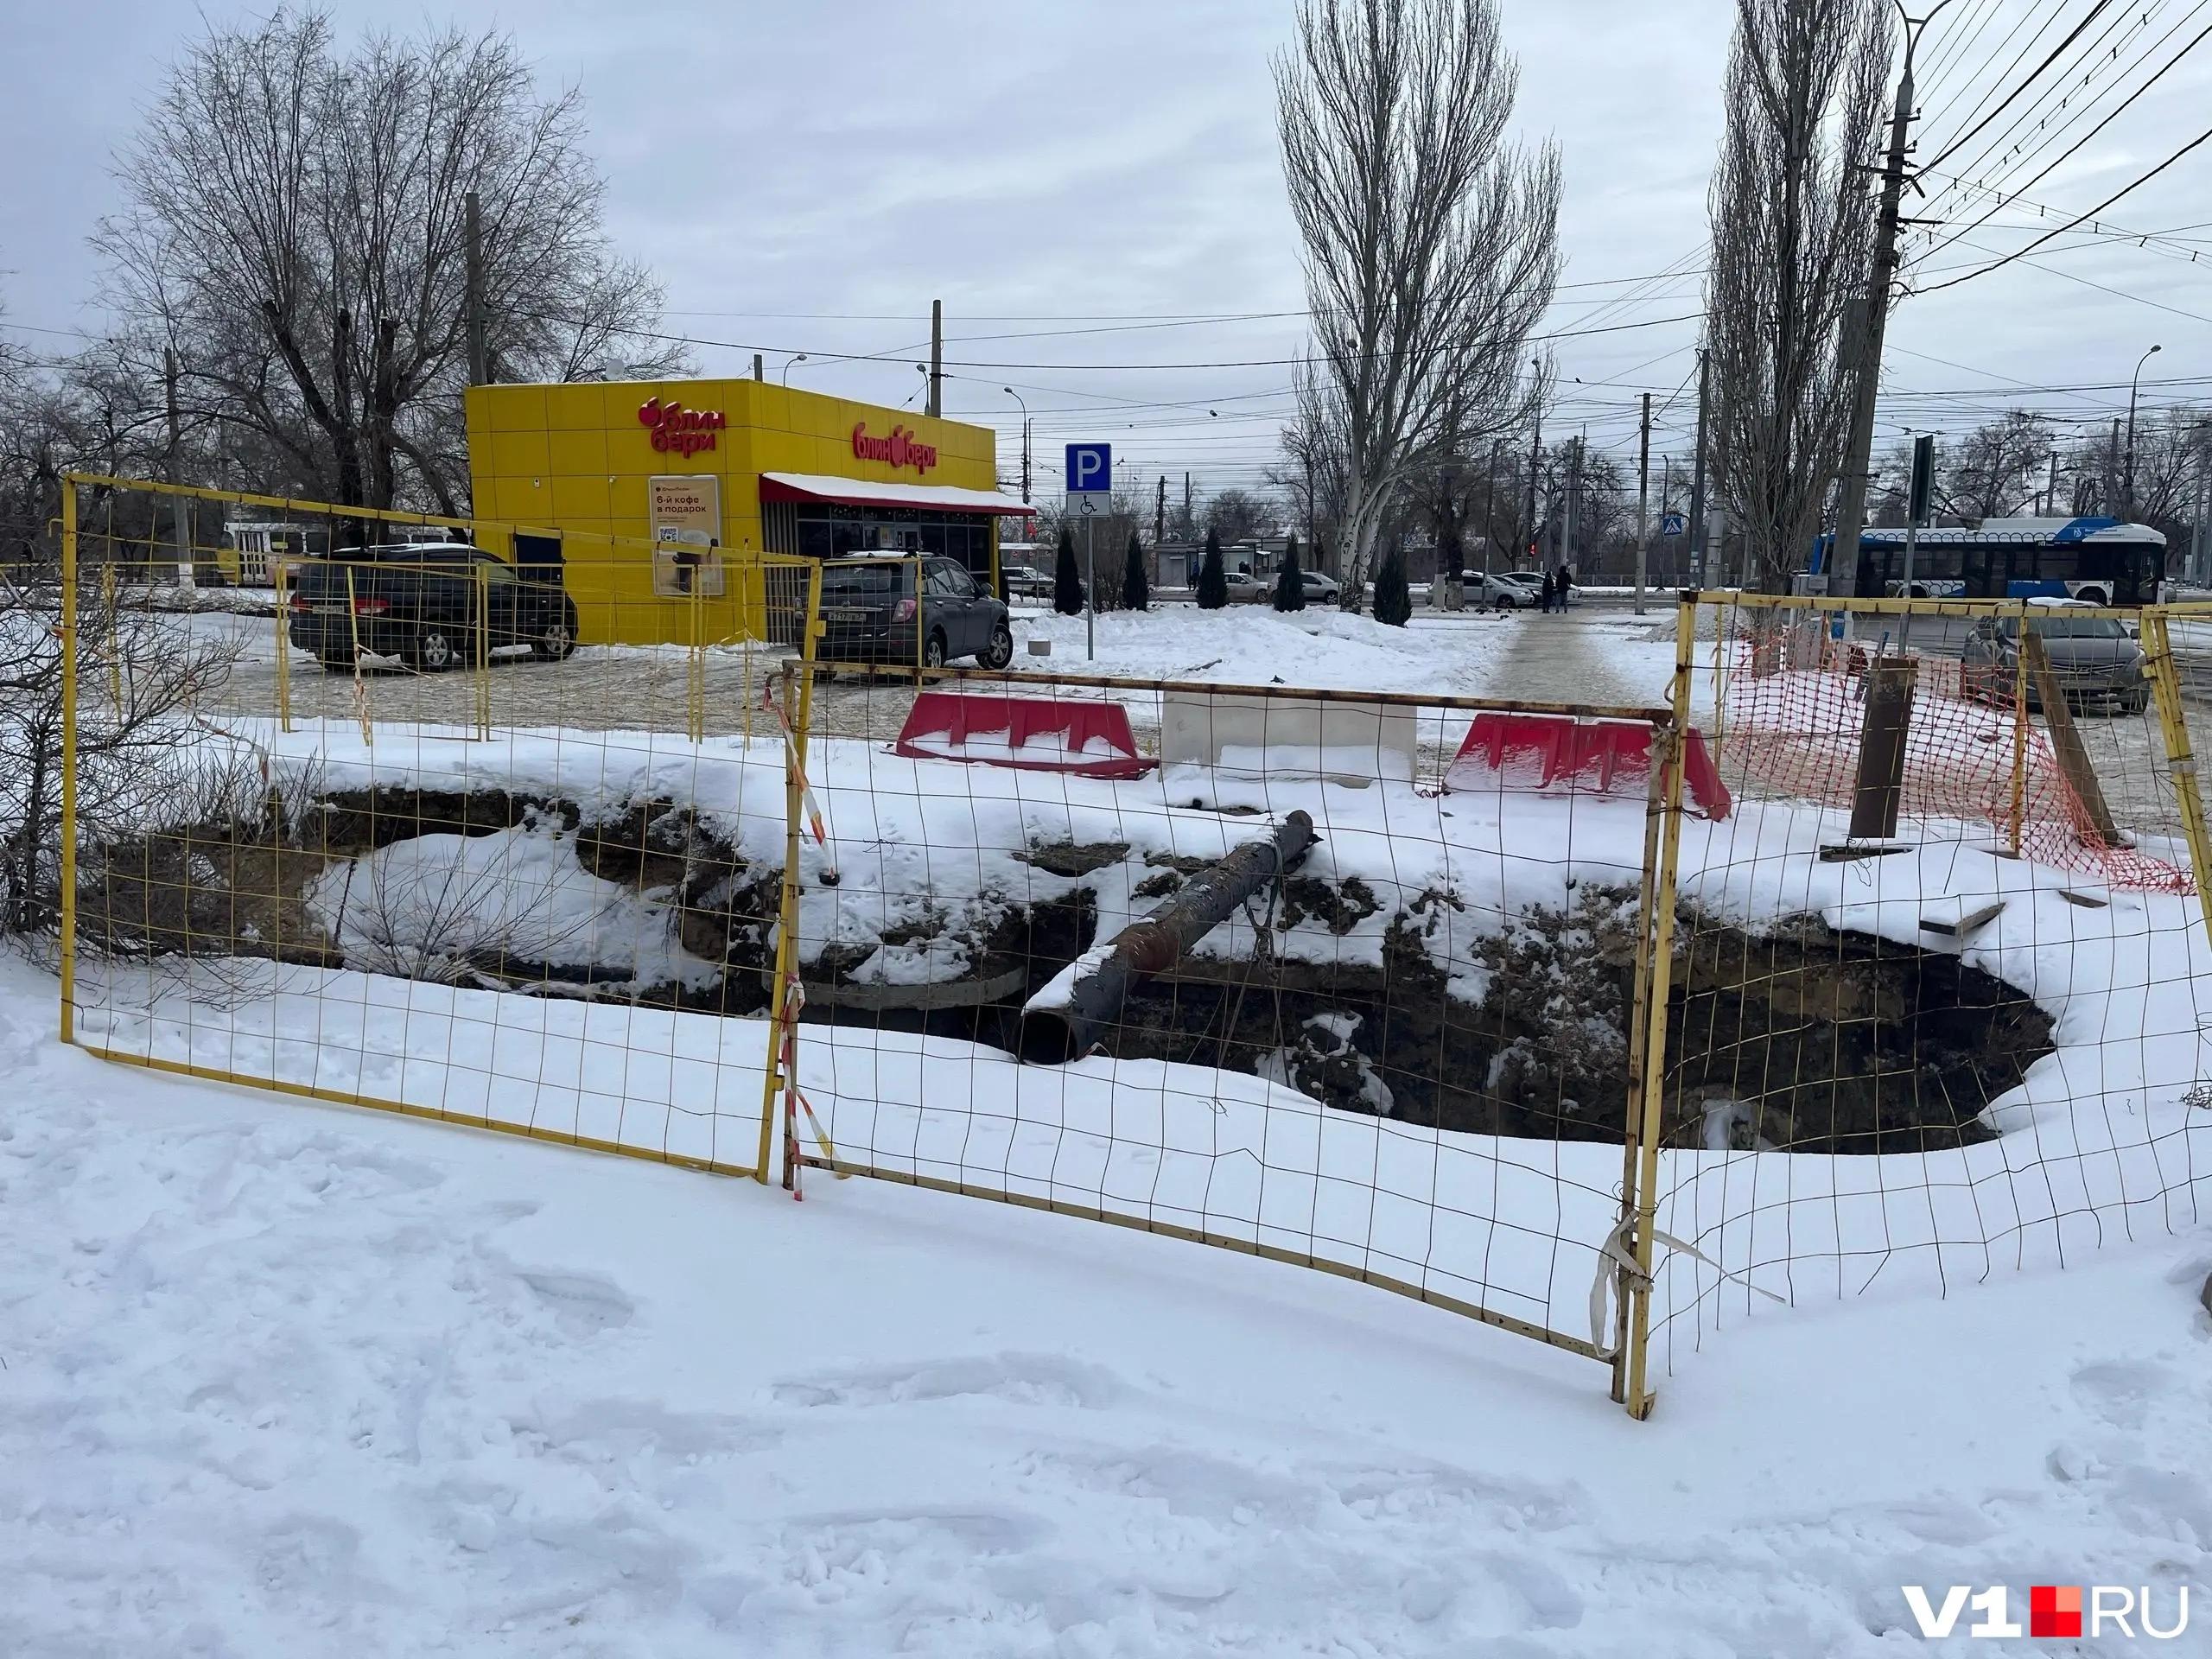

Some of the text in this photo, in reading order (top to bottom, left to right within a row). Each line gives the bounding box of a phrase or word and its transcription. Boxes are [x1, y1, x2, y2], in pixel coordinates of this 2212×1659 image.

[663, 401, 725, 431] блин
[651, 423, 715, 459] бери
[1077, 450, 1101, 487] P
[657, 495, 699, 505] 6-й кофе
